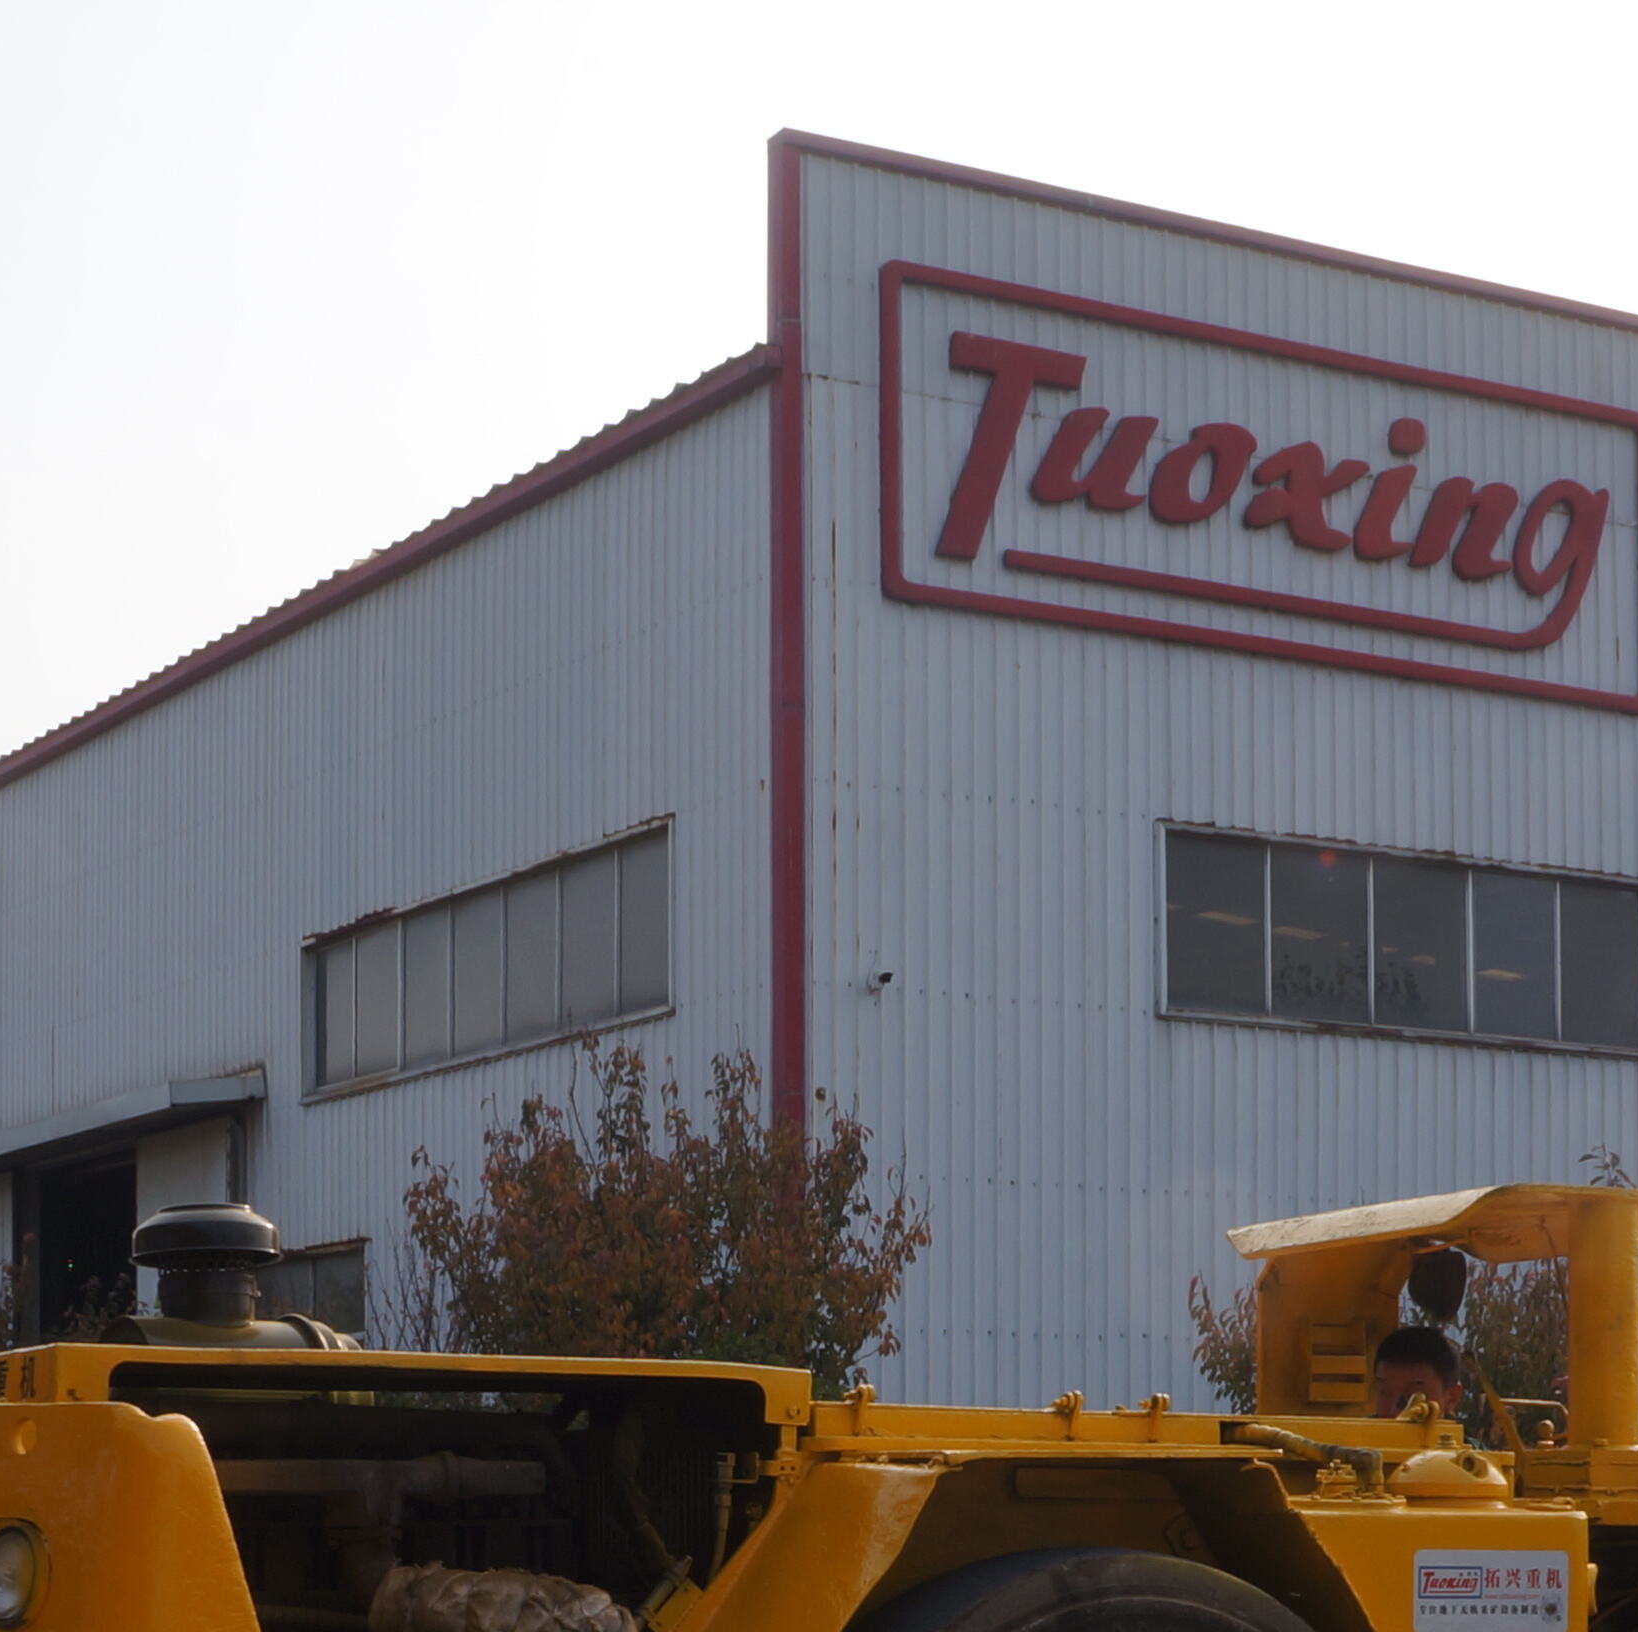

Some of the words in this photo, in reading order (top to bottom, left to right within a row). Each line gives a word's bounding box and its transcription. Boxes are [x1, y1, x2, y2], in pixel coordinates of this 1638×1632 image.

[935, 329, 1609, 650] Tuoxing
[1422, 1571, 1479, 1594] Tuoxing
[1484, 1568, 1563, 1589] 拓兴重机
